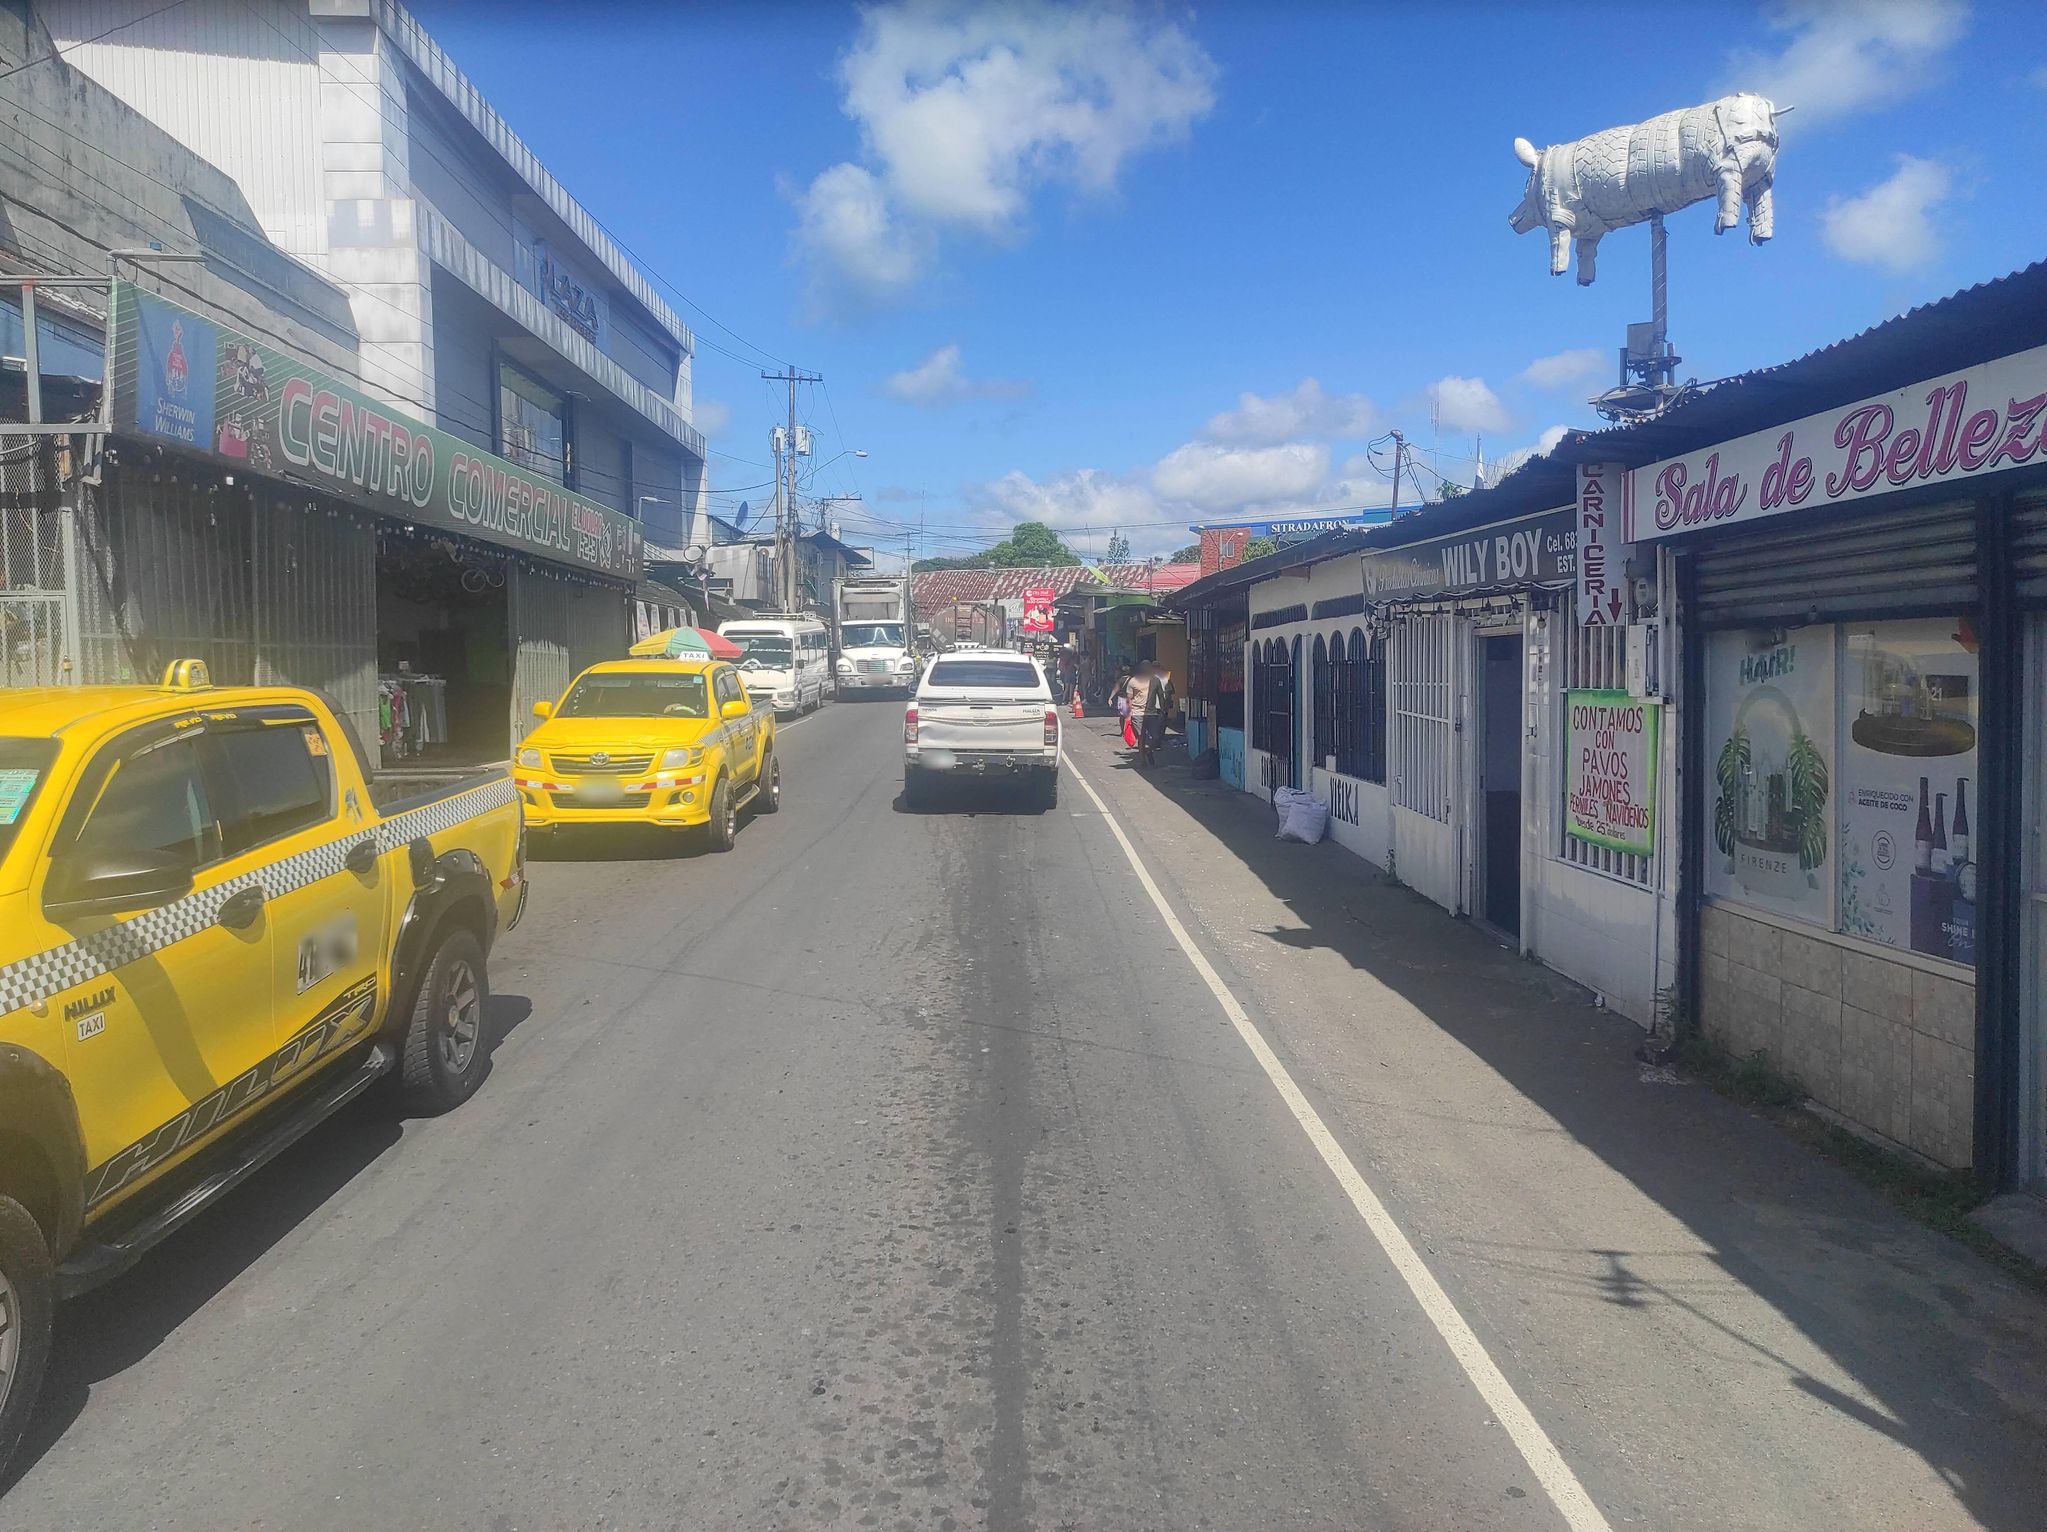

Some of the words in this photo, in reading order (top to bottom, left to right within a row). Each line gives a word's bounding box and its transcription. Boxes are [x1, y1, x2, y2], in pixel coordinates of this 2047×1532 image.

[156, 397, 196, 425] SHERWIN
[155, 415, 194, 442] WILLIAMS
[278, 376, 435, 508] CENTRO
[448, 451, 571, 552] COMERCIAL
[1654, 450, 1747, 530] Sala
[1759, 430, 1815, 511] de
[1825, 380, 2047, 499] Bellez
[1547, 533, 1563, 553] Cel.
[1582, 464, 1607, 625] CARNICERIA
[1441, 539, 1489, 587] WILY
[1495, 528, 1543, 580] BOY
[1557, 554, 1576, 574] EST.
[1573, 705, 1644, 734] CONTAMOS
[1595, 730, 1615, 750] CON
[1582, 748, 1628, 779] PAVOS
[1579, 775, 1631, 806] JAMONES
[1858, 788, 1898, 801] ENRIQUECIDO
[1900, 794, 1914, 803] CON
[1570, 792, 1599, 819] PERNILES
[1858, 799, 1879, 808] ACEITE
[1880, 801, 1889, 809] DE
[1890, 802, 1908, 812] COCO
[1741, 853, 1787, 873] FIRENZE
[343, 976, 376, 999] TRD
[64, 986, 117, 1022] HILUX
[79, 1014, 104, 1038] TAXI
[88, 995, 372, 1207] HILUX
